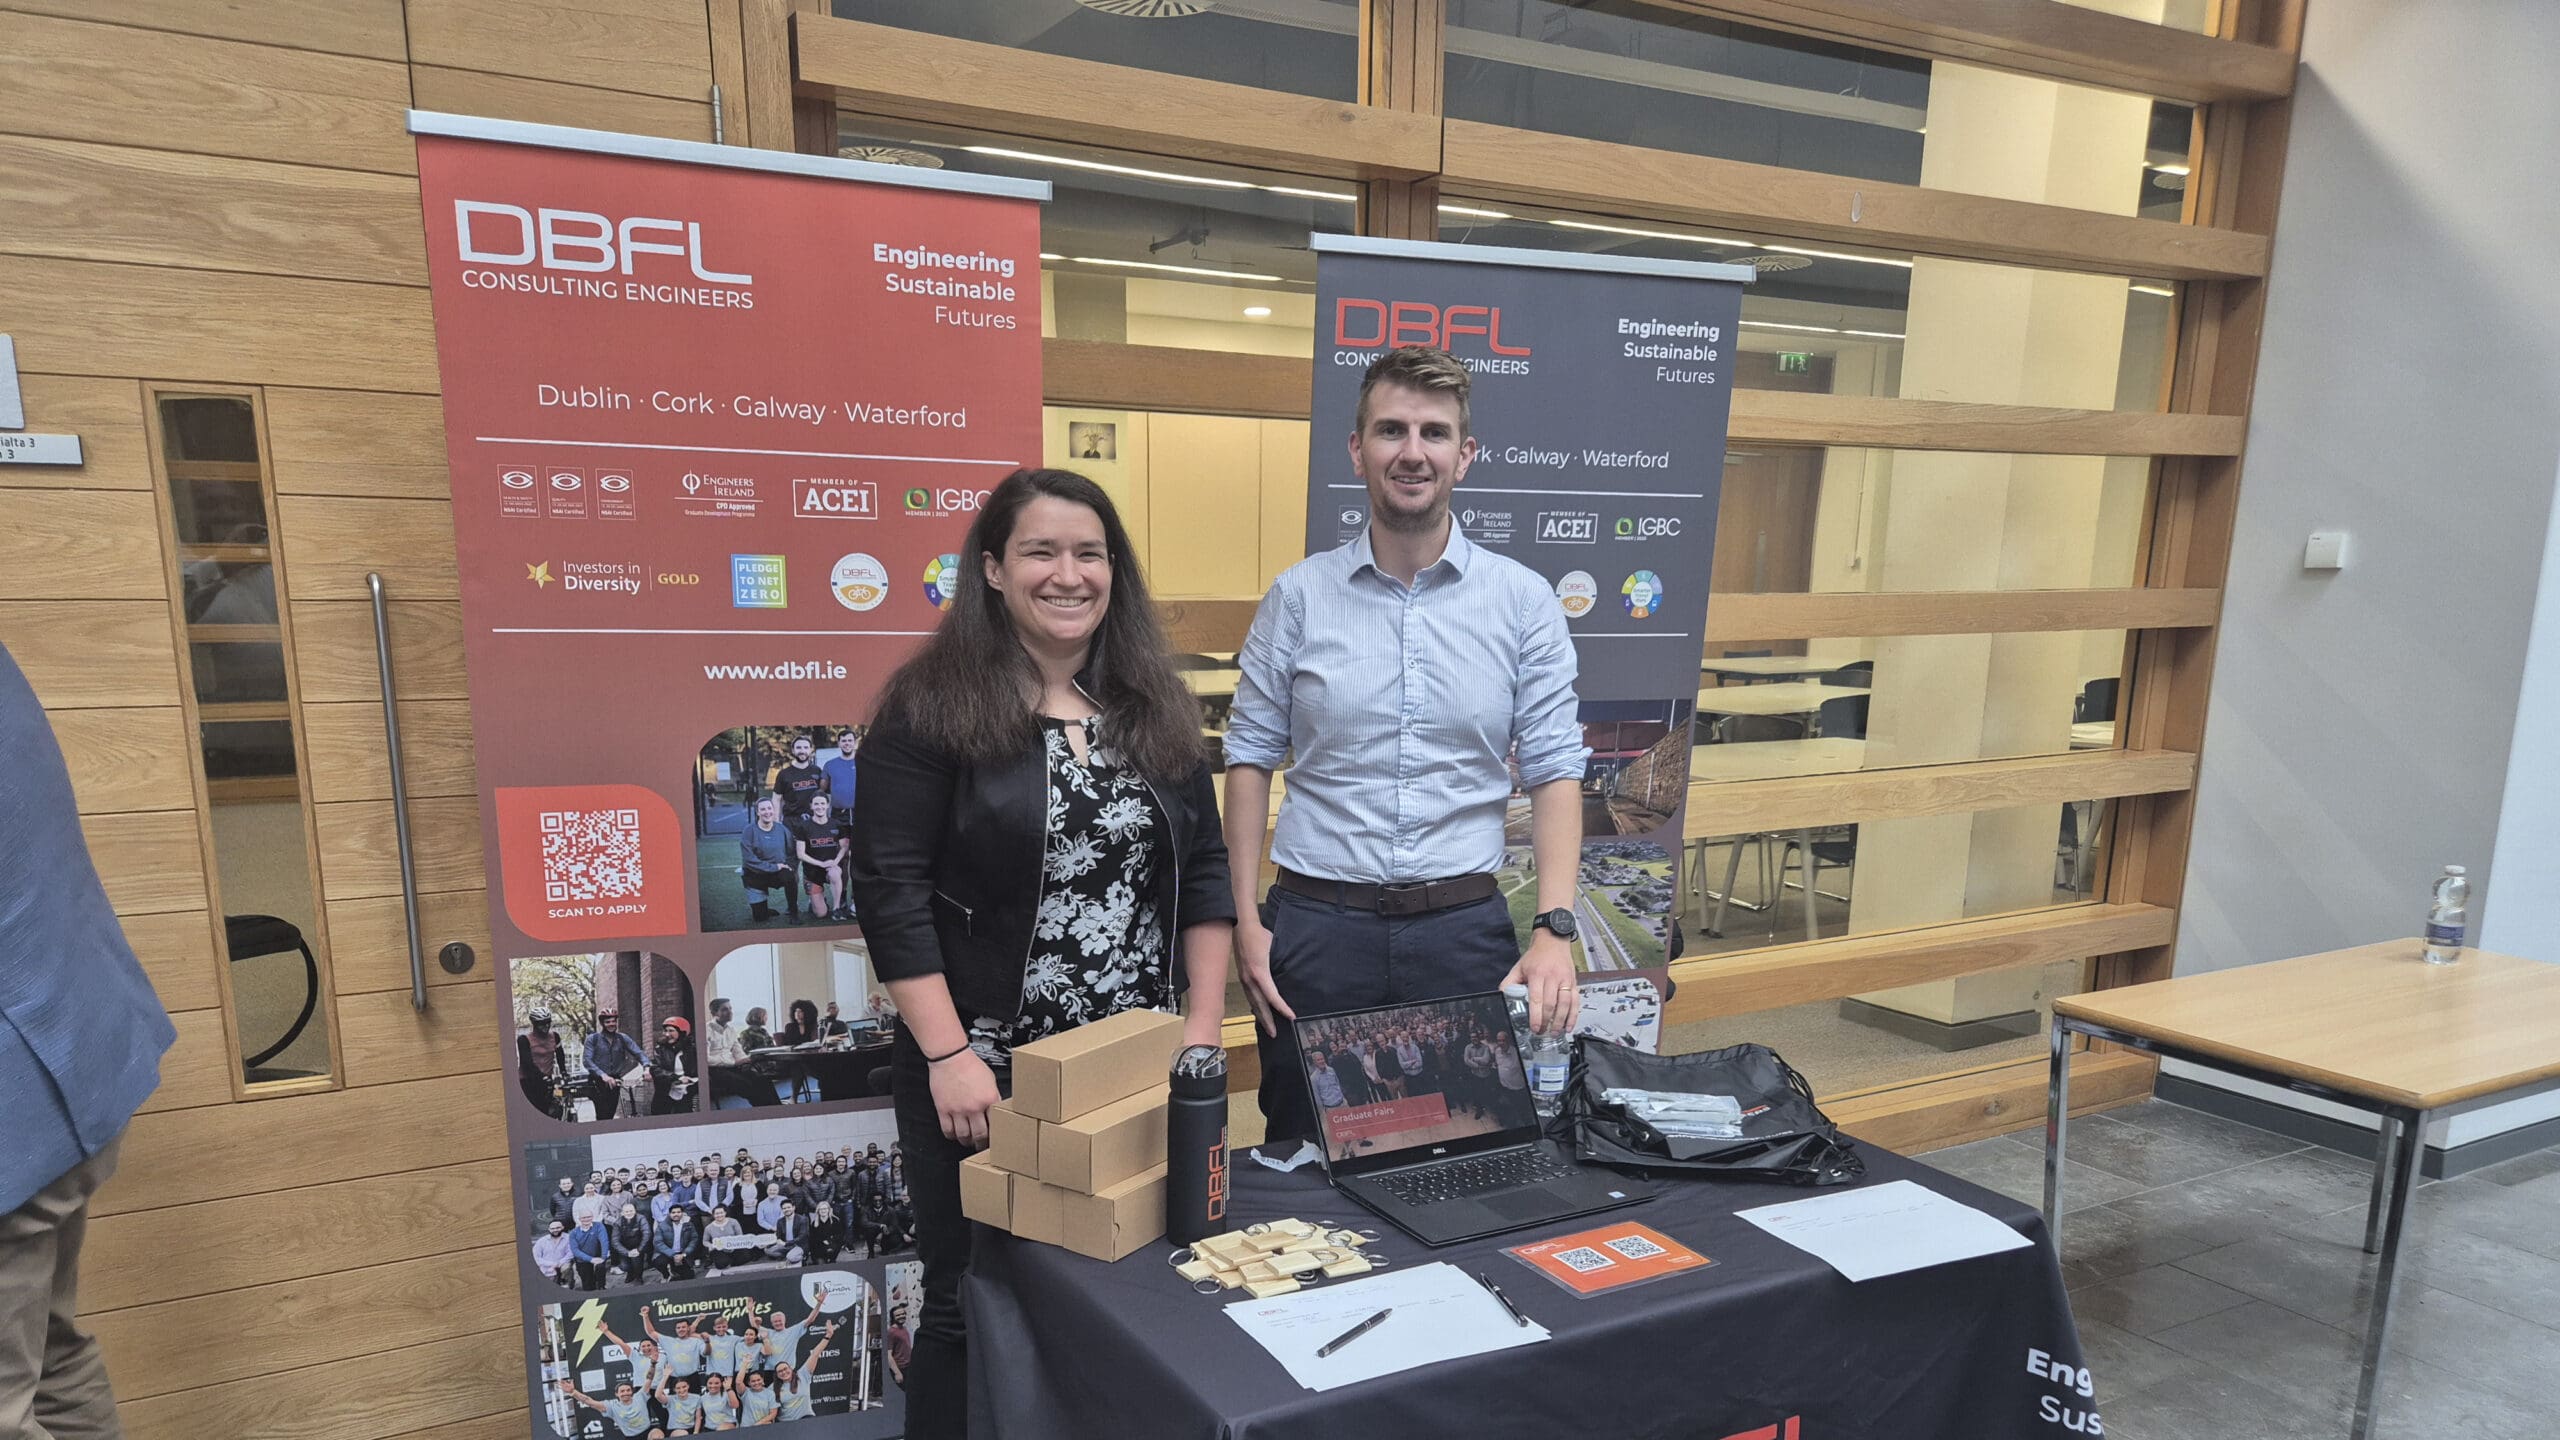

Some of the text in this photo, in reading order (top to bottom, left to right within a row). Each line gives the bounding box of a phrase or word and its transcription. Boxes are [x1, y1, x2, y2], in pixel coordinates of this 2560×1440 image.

[454, 199, 753, 286] DBFL
[873, 242, 1016, 278] Engineering
[461, 269, 754, 310] CONSULTING ENGINEERS
[886, 272, 1016, 302] Sustainable
[935, 306, 1017, 330] Futures
[1335, 297, 1532, 357] DBFL
[1617, 318, 1720, 342] Engineering
[1623, 342, 1718, 363] Sustainable
[1656, 366, 1716, 385] Futures
[538, 384, 967, 429] Dublin Cork Galway Waterford
[28, 437, 35, 448] 3
[1473, 446, 1669, 470] rk Galway Waterford
[703, 475, 754, 487] ENGINEERS
[810, 478, 845, 486] MEMBER
[714, 486, 755, 497] IRELAND
[803, 487, 870, 513] ACEI
[1543, 519, 1593, 539] ACEI
[1638, 517, 1681, 537] IGBC
[563, 560, 641, 574] Investors in
[739, 563, 779, 573] PLEDGE
[842, 568, 877, 577] DBFL
[564, 575, 641, 595] Diversity
[657, 573, 700, 585] GOLD
[740, 575, 779, 586] TO NET
[740, 588, 780, 600] ZERO
[704, 660, 847, 683] www.dbfl.ie
[548, 903, 648, 920] SCAN TO APPLY
[1332, 1107, 1396, 1124] Graduate Fairs
[1208, 1127, 1225, 1221] DBFL
[658, 1296, 749, 1317] Momentum
